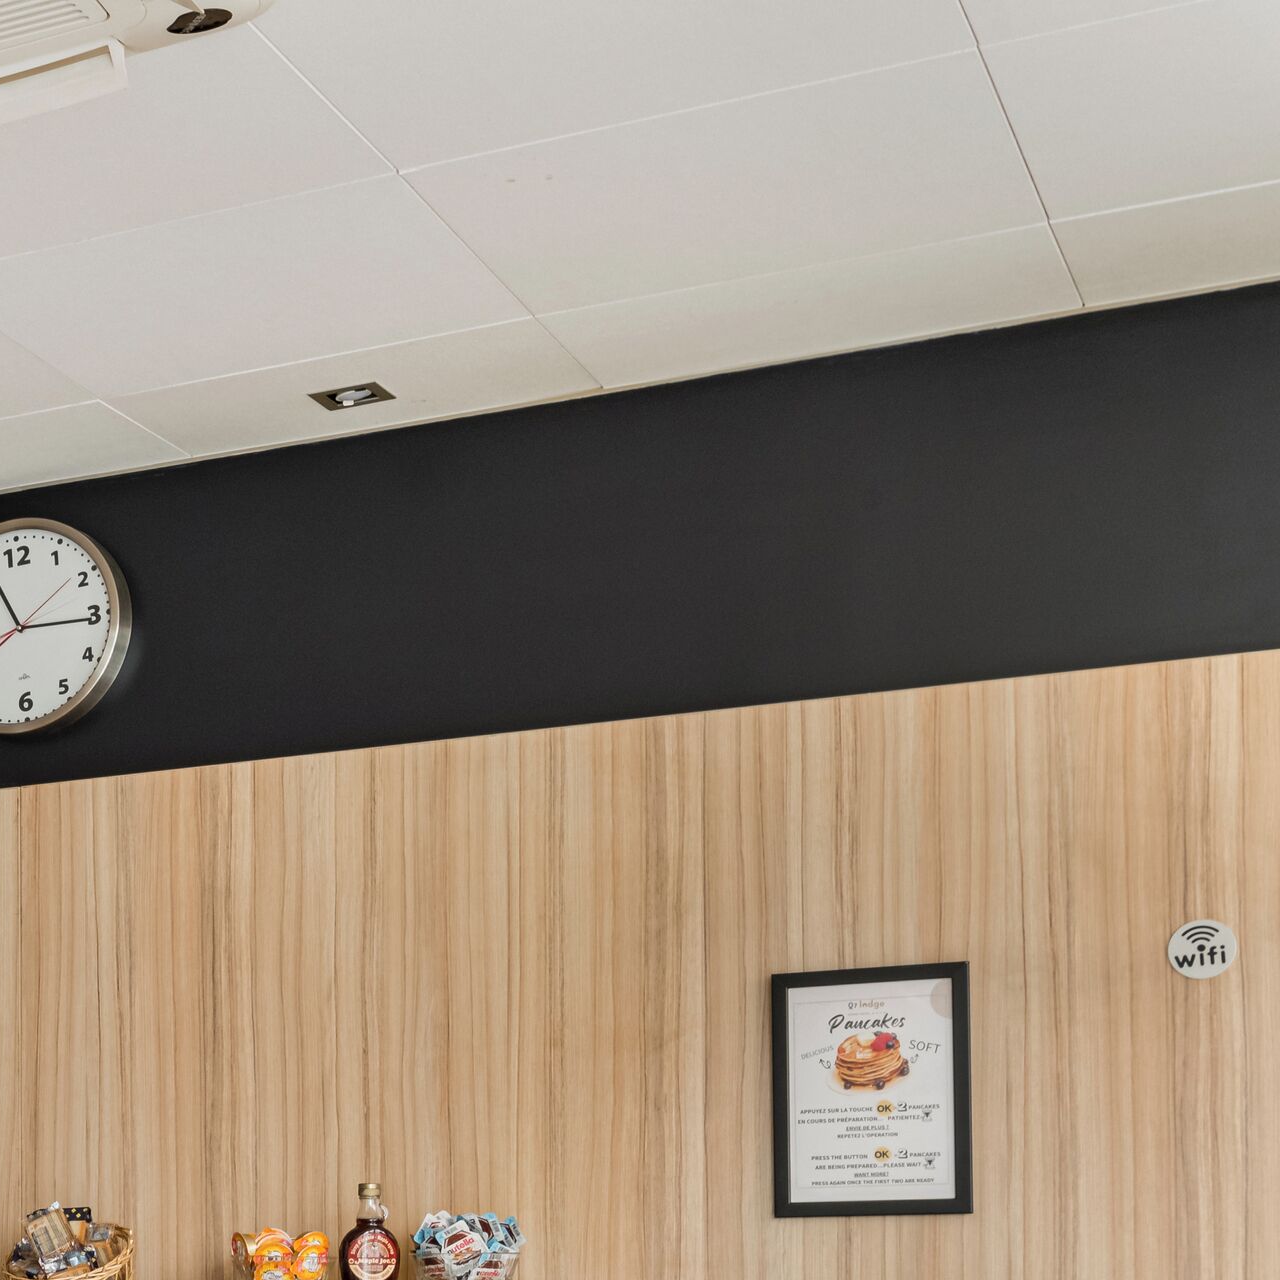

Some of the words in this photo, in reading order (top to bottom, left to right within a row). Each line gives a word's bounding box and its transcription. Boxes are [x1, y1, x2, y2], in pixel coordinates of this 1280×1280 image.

[3, 546, 31, 568] 12
[51, 551, 59, 566] 1
[77, 571, 89, 587] 2
[87, 605, 101, 625] 3
[82, 647, 94, 662] 4
[58, 678, 69, 695] 5
[18, 691, 34, 711] 6
[1174, 944, 1226, 968] wifi
[828, 1013, 906, 1034] Pancakes
[801, 1045, 834, 1060] DELICIOUS
[909, 1039, 940, 1054] SOFT
[877, 1104, 892, 1113] OK
[874, 1150, 889, 1158] OK
[447, 1236, 475, 1254] nutella
